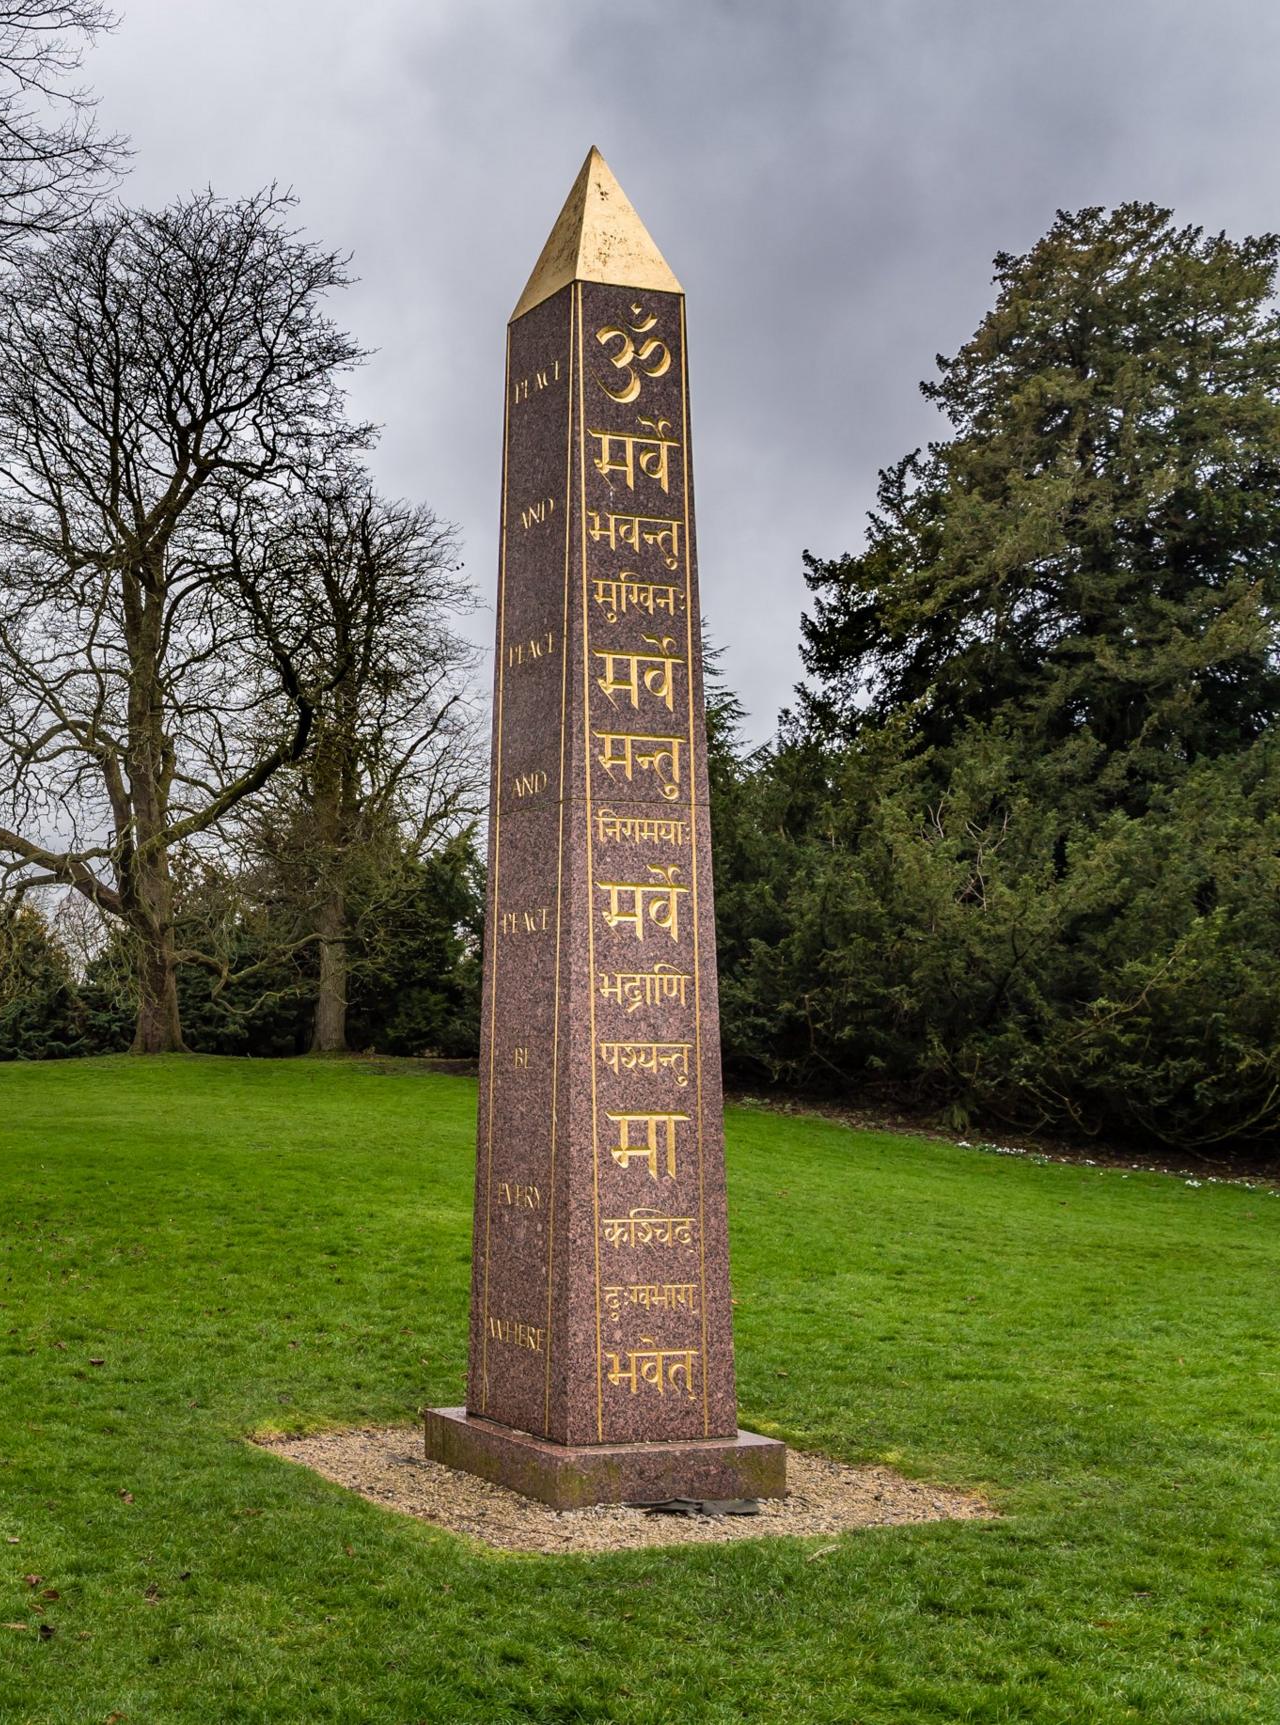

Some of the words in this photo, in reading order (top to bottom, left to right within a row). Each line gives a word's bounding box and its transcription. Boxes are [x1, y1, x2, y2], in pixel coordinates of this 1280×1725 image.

[587, 415, 680, 494] सर्वे
[587, 511, 683, 571] भवन्तु
[592, 572, 686, 623] सुखिनः
[592, 634, 685, 712] सर्वे
[511, 770, 548, 798] AND
[592, 730, 687, 800] सन्तु
[595, 808, 692, 845] निरामयाः
[502, 907, 550, 935] PEACE
[596, 863, 690, 943] सर्वे
[599, 963, 692, 1013] भद्राणि
[513, 1046, 533, 1070] BE
[599, 1040, 694, 1087] पश्यन्तु
[605, 1111, 692, 1181] मा
[497, 1182, 542, 1210] EVERY
[602, 1207, 696, 1253] कश्चिद्
[604, 1283, 699, 1322] दुःखभाग्
[488, 1316, 546, 1352] WHERE
[605, 1334, 699, 1400] भवेत्
